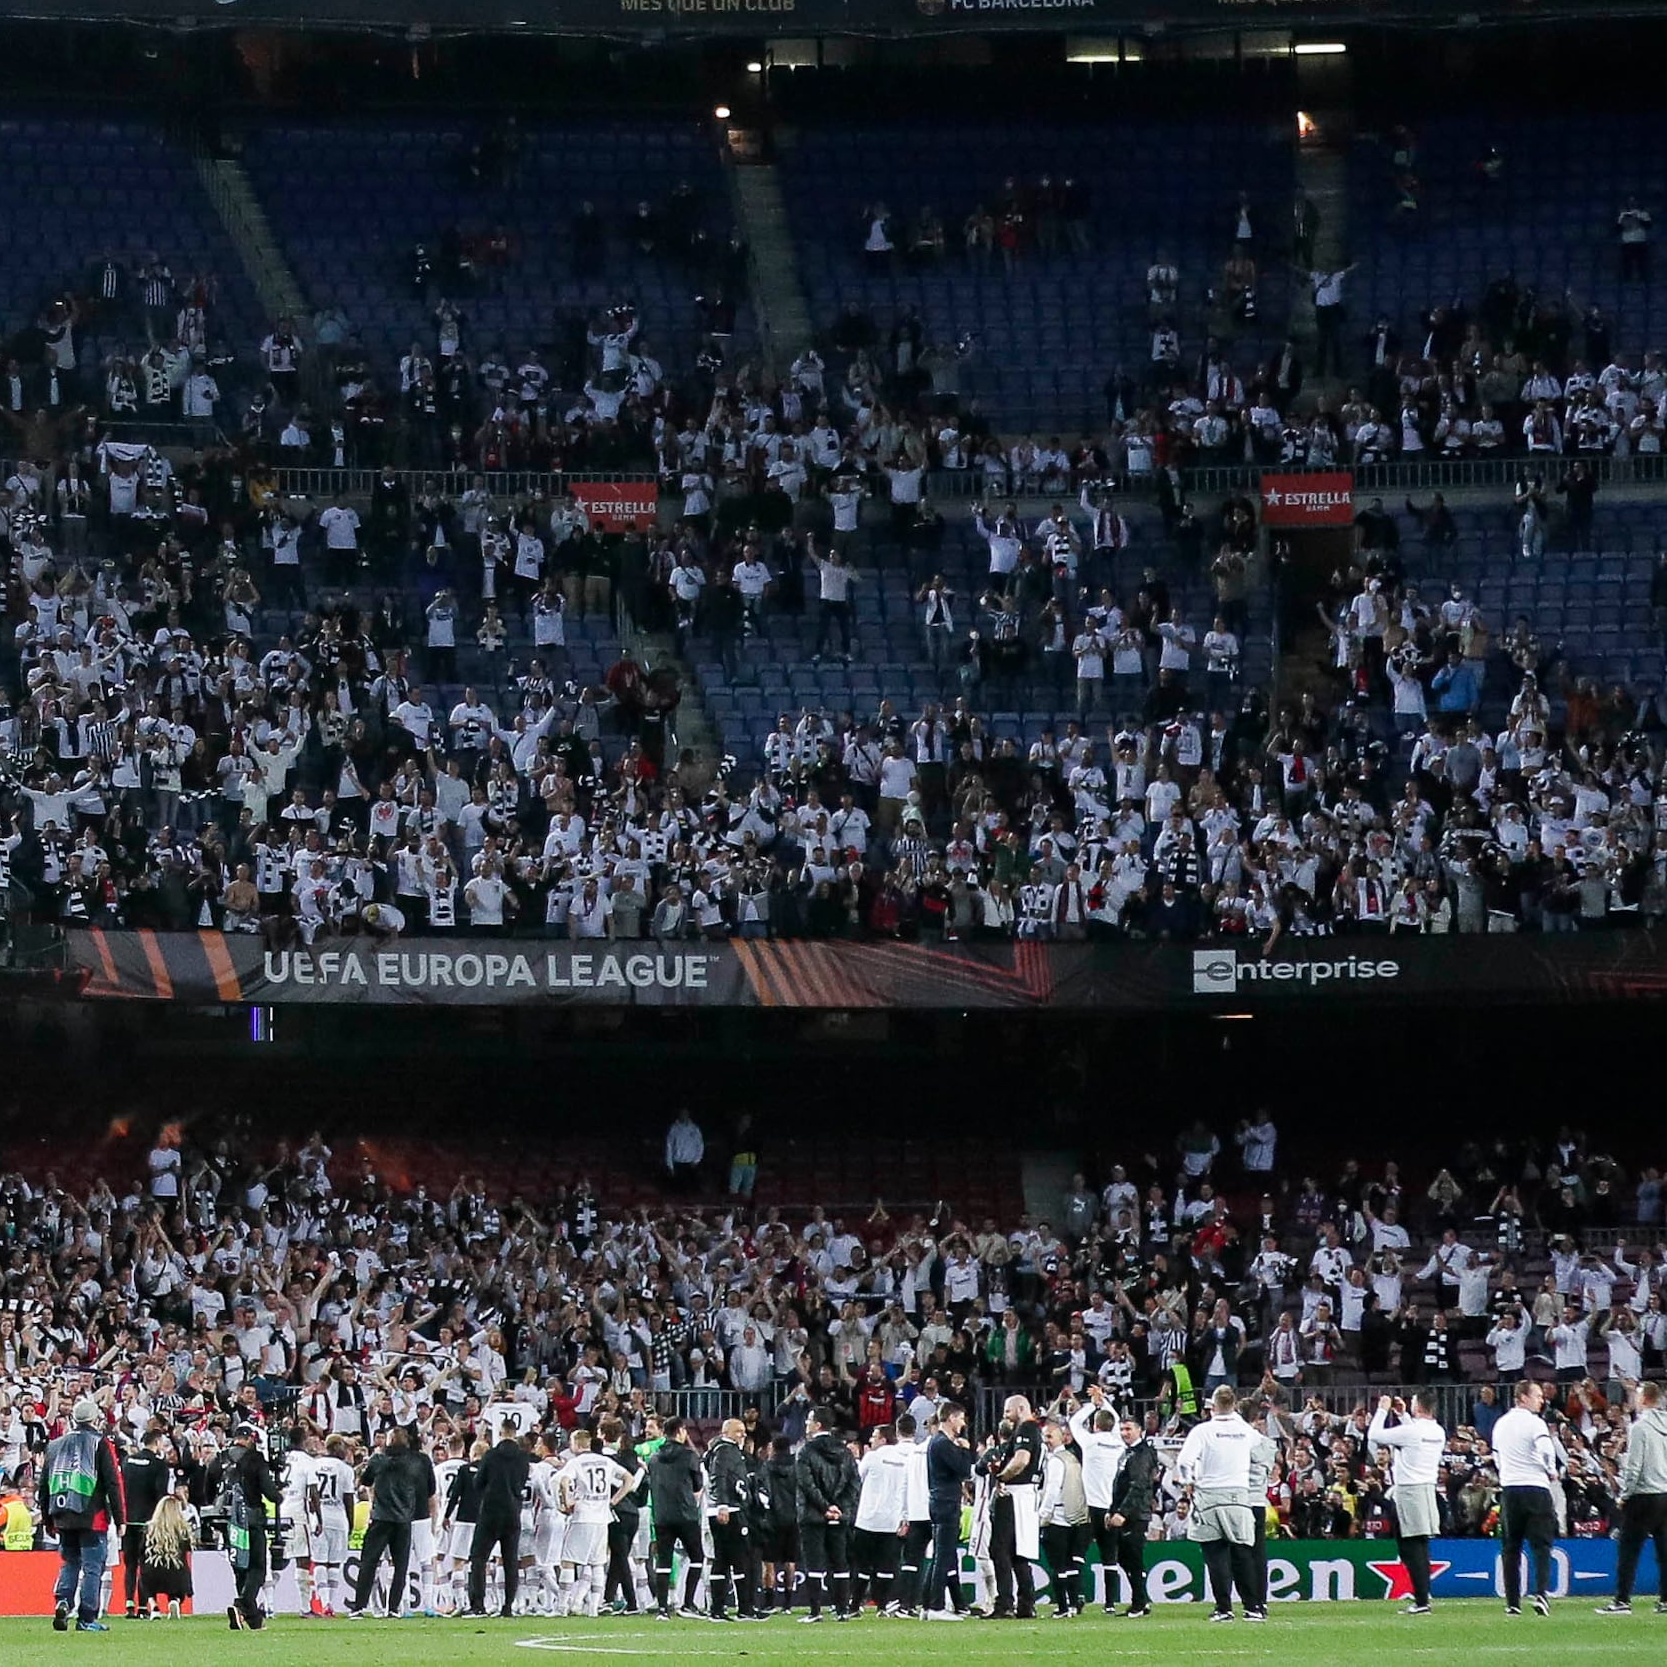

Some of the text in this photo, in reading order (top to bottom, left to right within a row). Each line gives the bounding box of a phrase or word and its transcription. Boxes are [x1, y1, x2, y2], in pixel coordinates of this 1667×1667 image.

[591, 500, 657, 515] ESTRELLA
[1284, 491, 1351, 506] ESTRELLA
[264, 950, 368, 986] UEFA
[378, 952, 538, 987] EUROPA
[1205, 954, 1400, 986] enterprise
[317, 1472, 338, 1500] 21
[586, 1467, 608, 1494] 13
